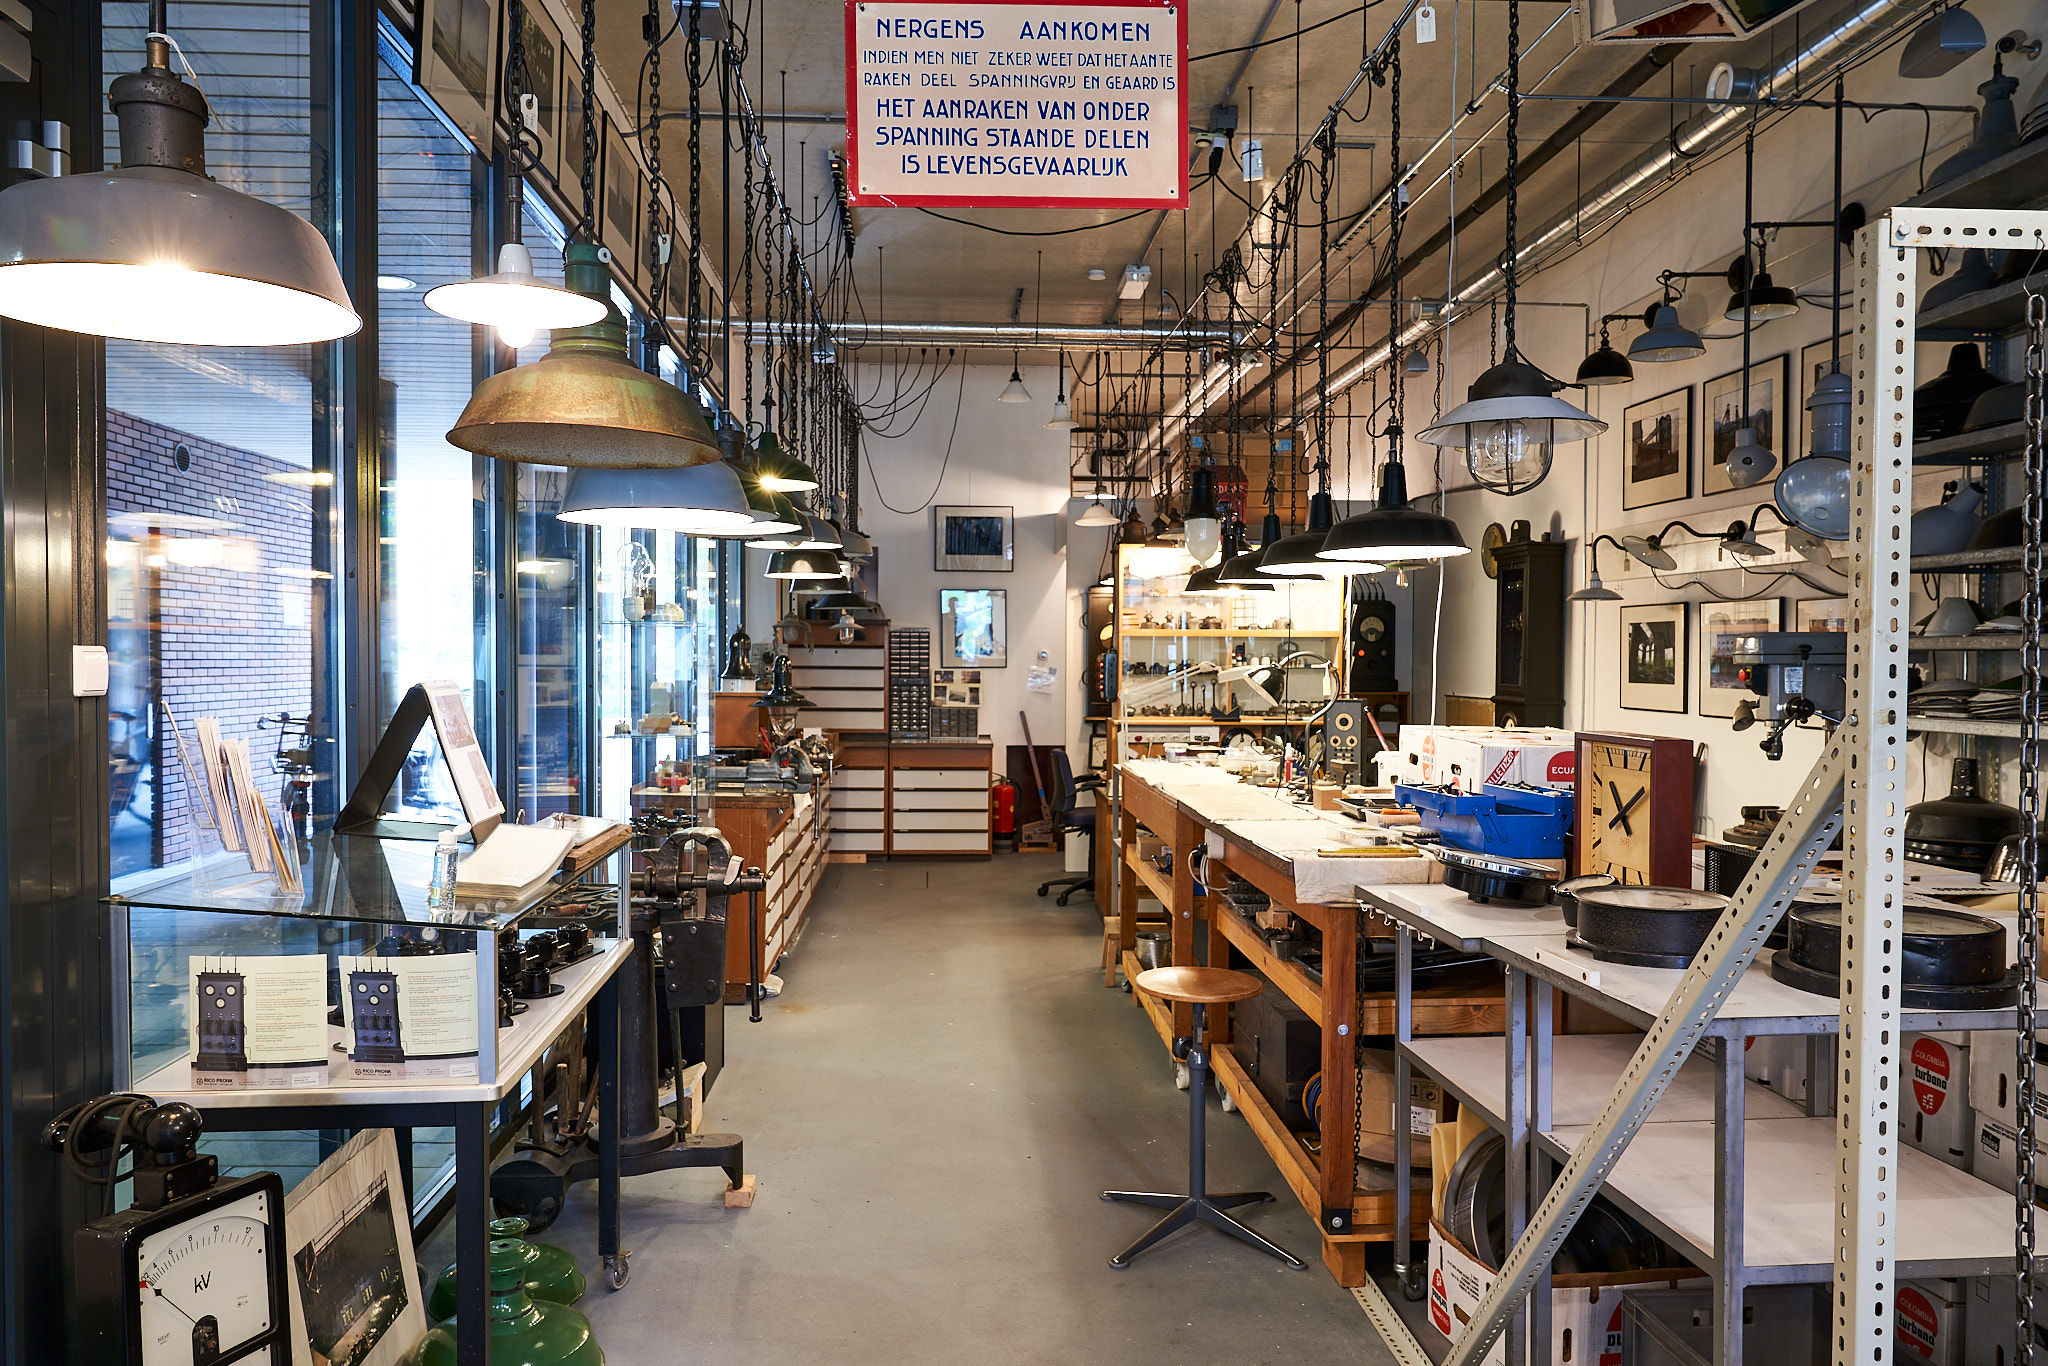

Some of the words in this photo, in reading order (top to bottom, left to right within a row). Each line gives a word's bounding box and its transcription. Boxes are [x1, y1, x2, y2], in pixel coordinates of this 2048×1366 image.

[877, 18, 985, 40] NERGENS
[1019, 20, 1150, 42] AANKOMEN
[863, 50, 908, 65] INDIEN
[914, 50, 944, 66] MEN
[951, 51, 979, 66] NIET
[988, 51, 1032, 67] ZEKER
[1035, 52, 1074, 68] WEET
[1077, 52, 1103, 68] DAT
[1104, 53, 1128, 68] HET
[1129, 54, 1157, 69] AAN
[1158, 54, 1173, 69] TE
[864, 72, 911, 87] RAKEN
[921, 73, 957, 88] DEEL
[1083, 75, 1100, 90] EN
[1105, 75, 1159, 91] GEAARD
[1162, 76, 1176, 91] IS
[877, 98, 916, 119] HET
[922, 99, 1028, 120] AANRAKEN
[1037, 100, 1076, 121] VAN
[1083, 101, 1150, 121] ONDER
[875, 126, 978, 147] SPANNING
[985, 127, 1076, 148] STAANDE
[1085, 129, 1149, 149] DELEN
[901, 154, 921, 174] IS
[927, 154, 1128, 177] LEVENSGEVAARLIJK
[1915, 1049, 1946, 1069] COLOMBIA
[1914, 1065, 1947, 1090] turbana
[245, 1226, 252, 1234] 12
[193, 1271, 212, 1294] kV
[1900, 1297, 1935, 1324] COLOMBIA
[1898, 1313, 1936, 1346] turbana
